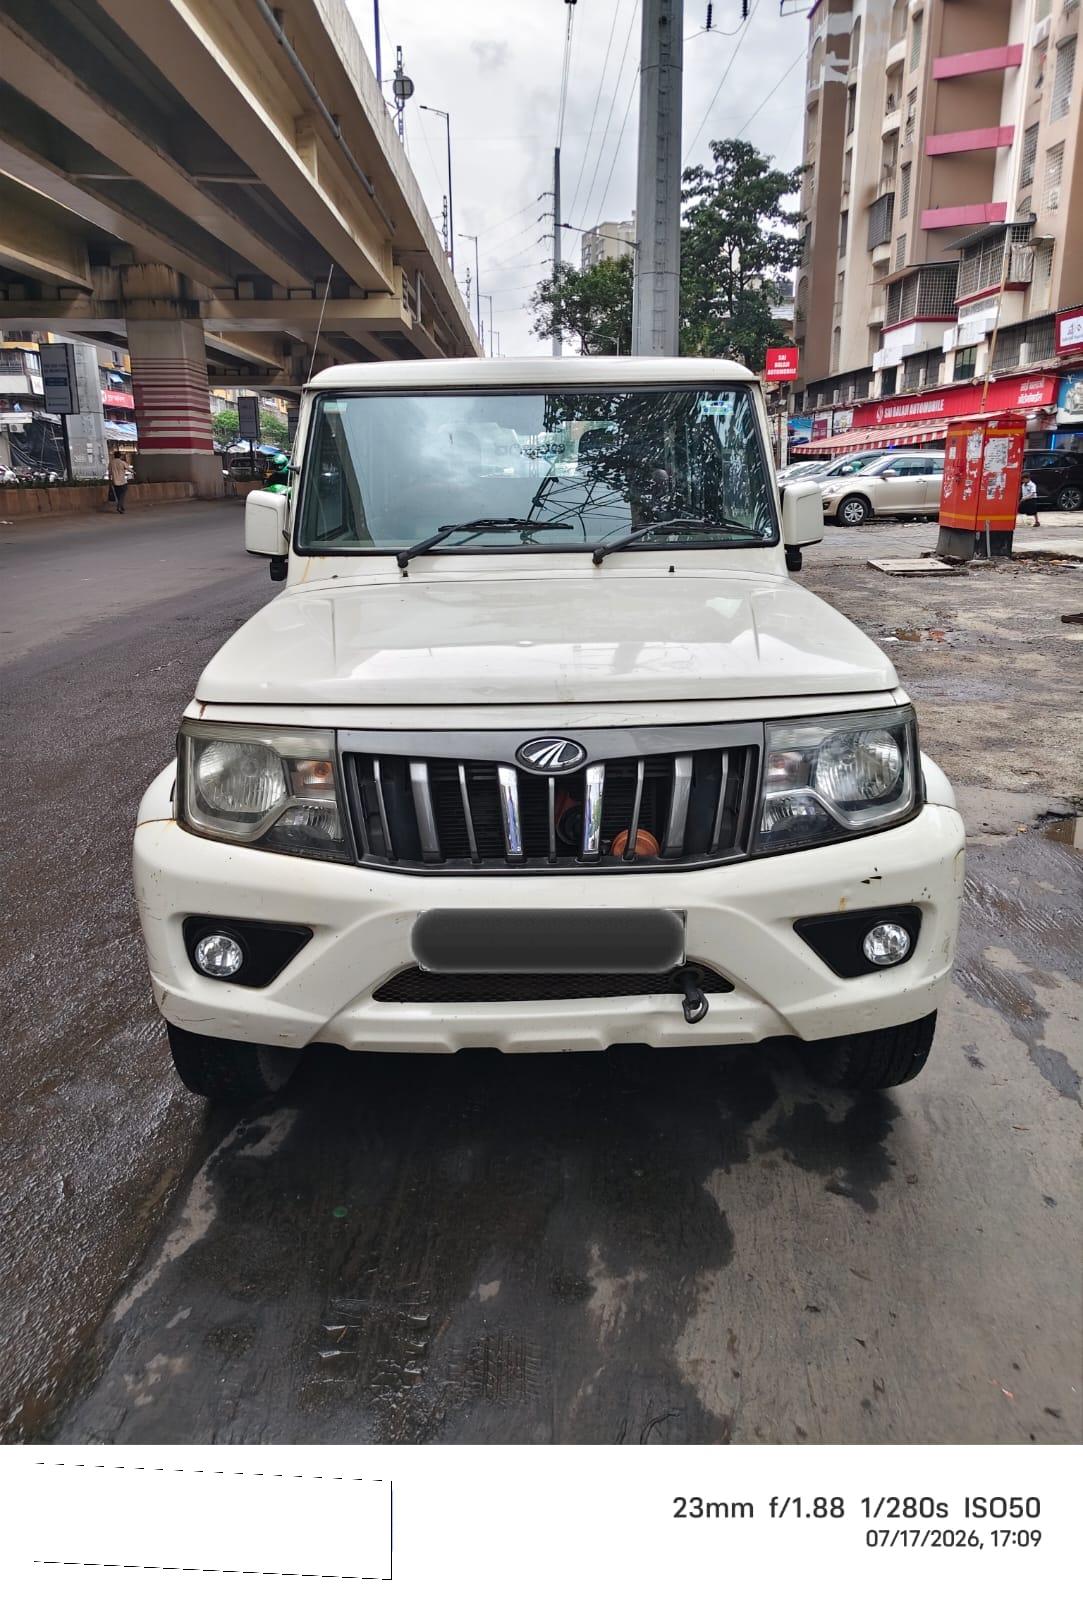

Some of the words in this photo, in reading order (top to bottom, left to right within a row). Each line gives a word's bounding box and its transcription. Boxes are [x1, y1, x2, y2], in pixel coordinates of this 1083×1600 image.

[767, 368, 797, 376] AUTOMOBILE
[884, 406, 893, 419] SAI
[910, 399, 945, 415] AUTOMOBILE
